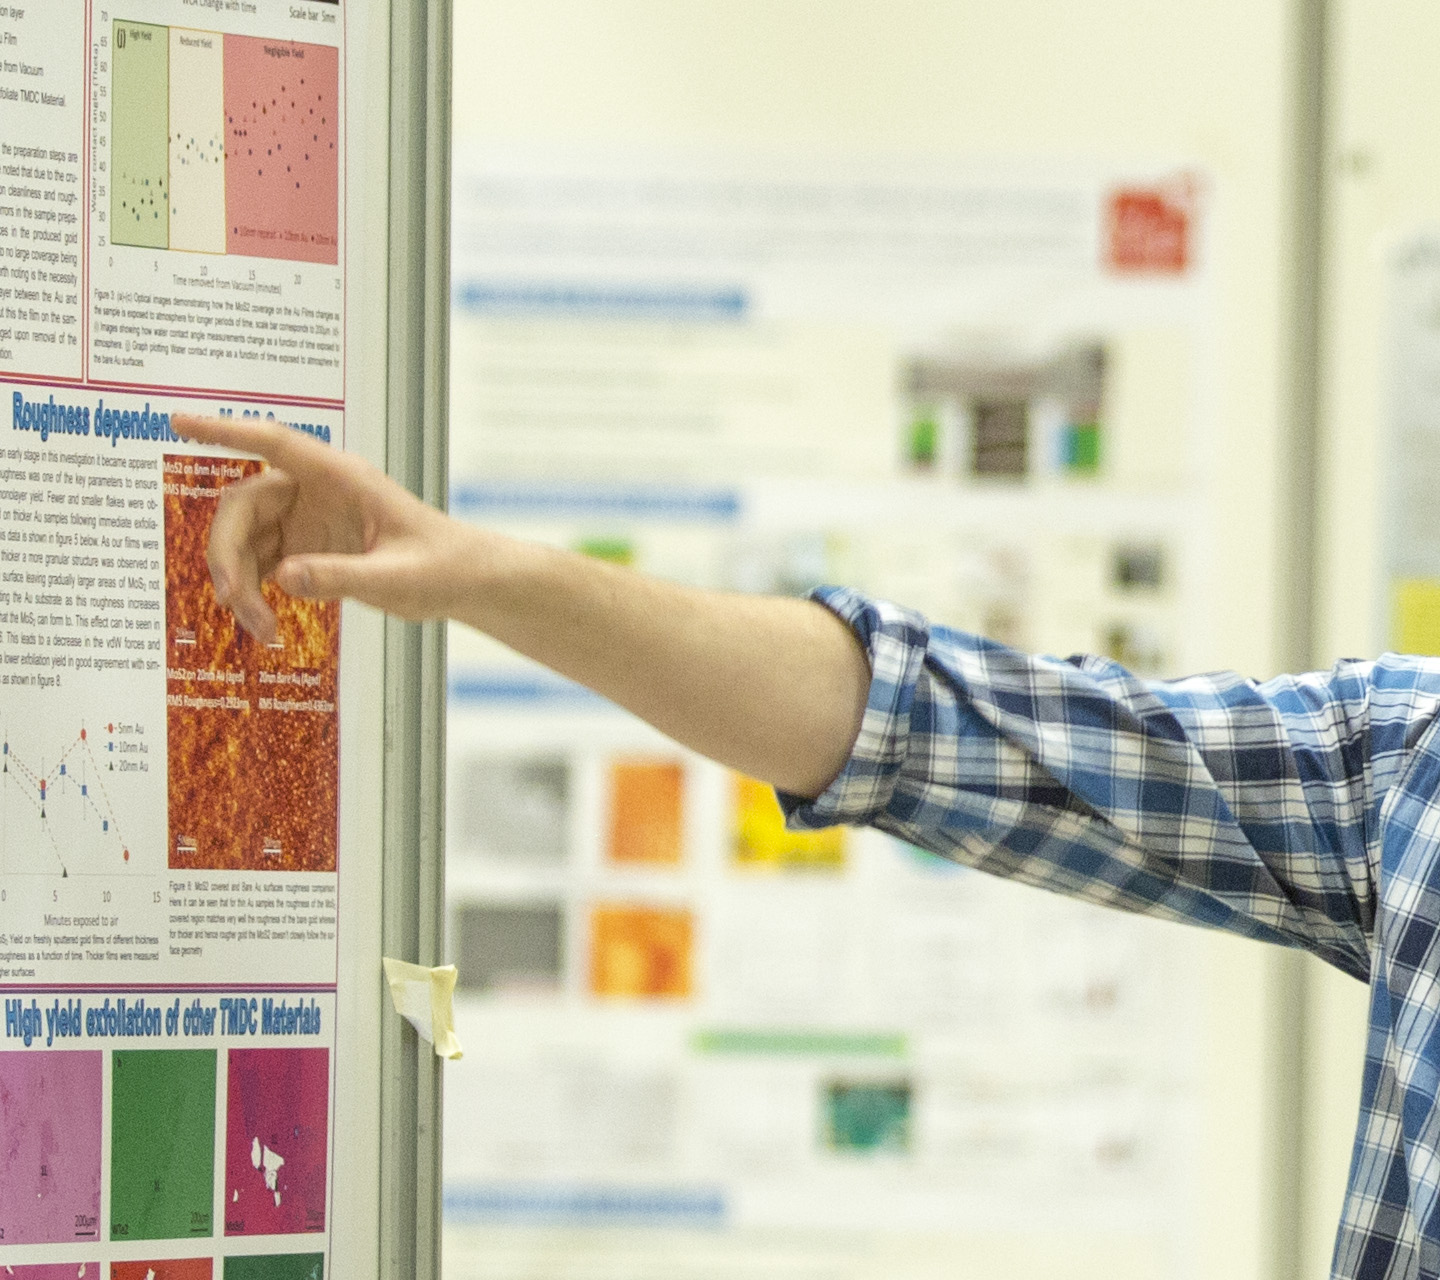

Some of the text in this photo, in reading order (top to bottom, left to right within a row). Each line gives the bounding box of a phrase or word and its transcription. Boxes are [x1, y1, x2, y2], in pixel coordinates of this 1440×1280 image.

[12, 390, 91, 440] Roughness
[4, 996, 322, 1046] High yield exfoliation of other TMDC Materials
